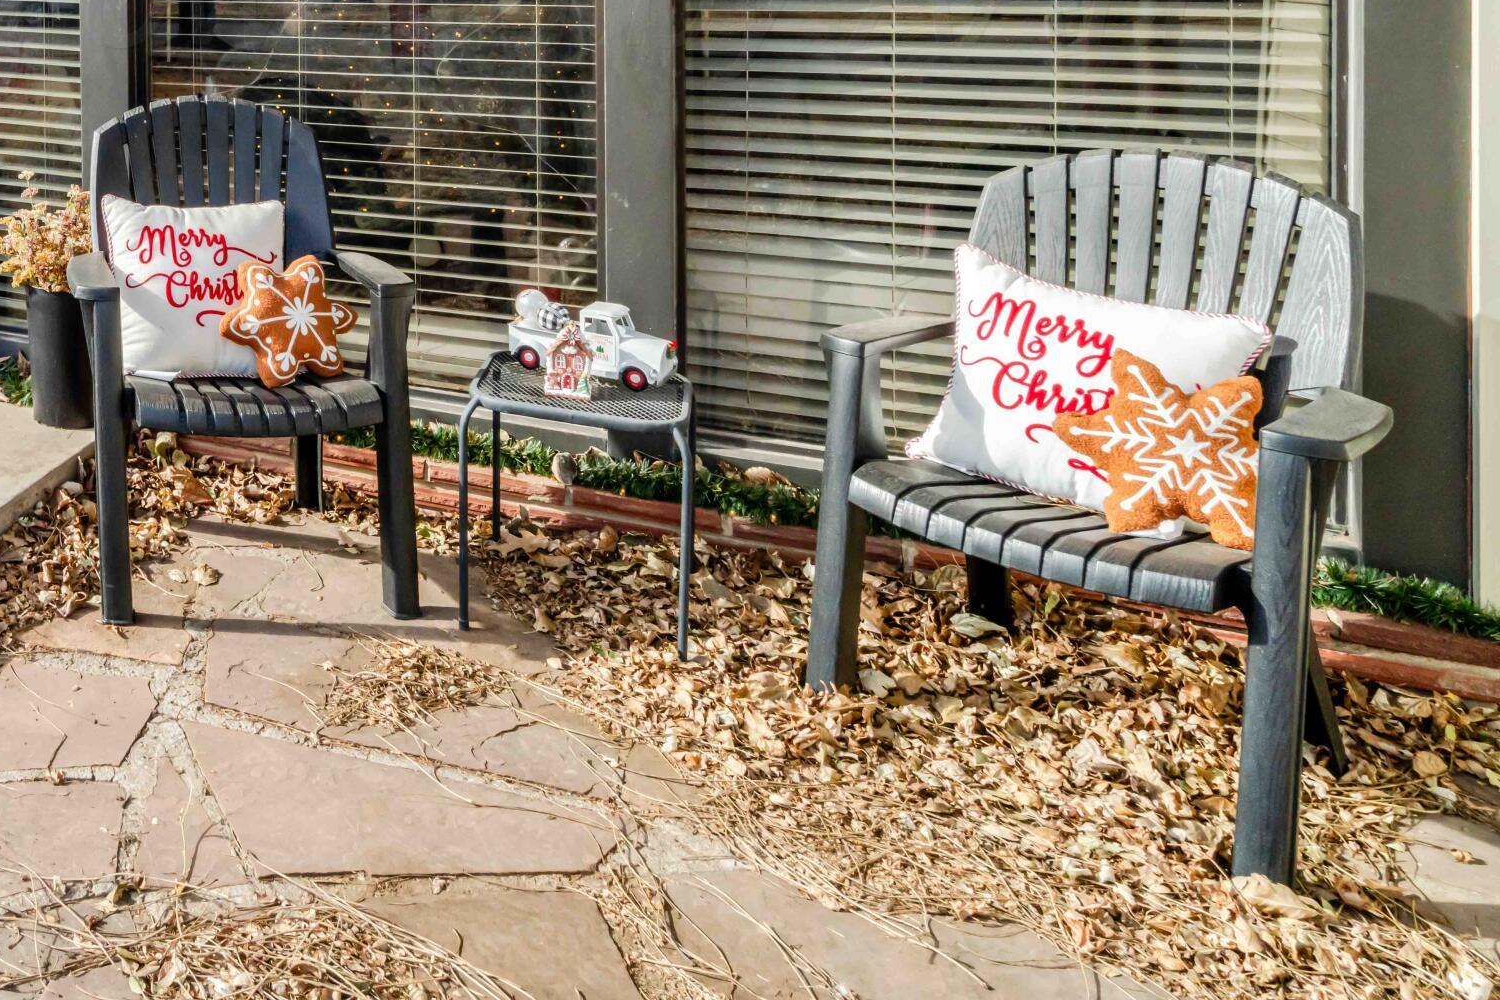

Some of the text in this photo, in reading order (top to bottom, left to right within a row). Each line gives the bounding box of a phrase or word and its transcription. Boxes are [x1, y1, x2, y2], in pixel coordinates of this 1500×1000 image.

[126, 225, 277, 267] Merry
[126, 270, 244, 308] Christ
[968, 292, 1114, 377] Merry
[961, 345, 1114, 415] Christ
